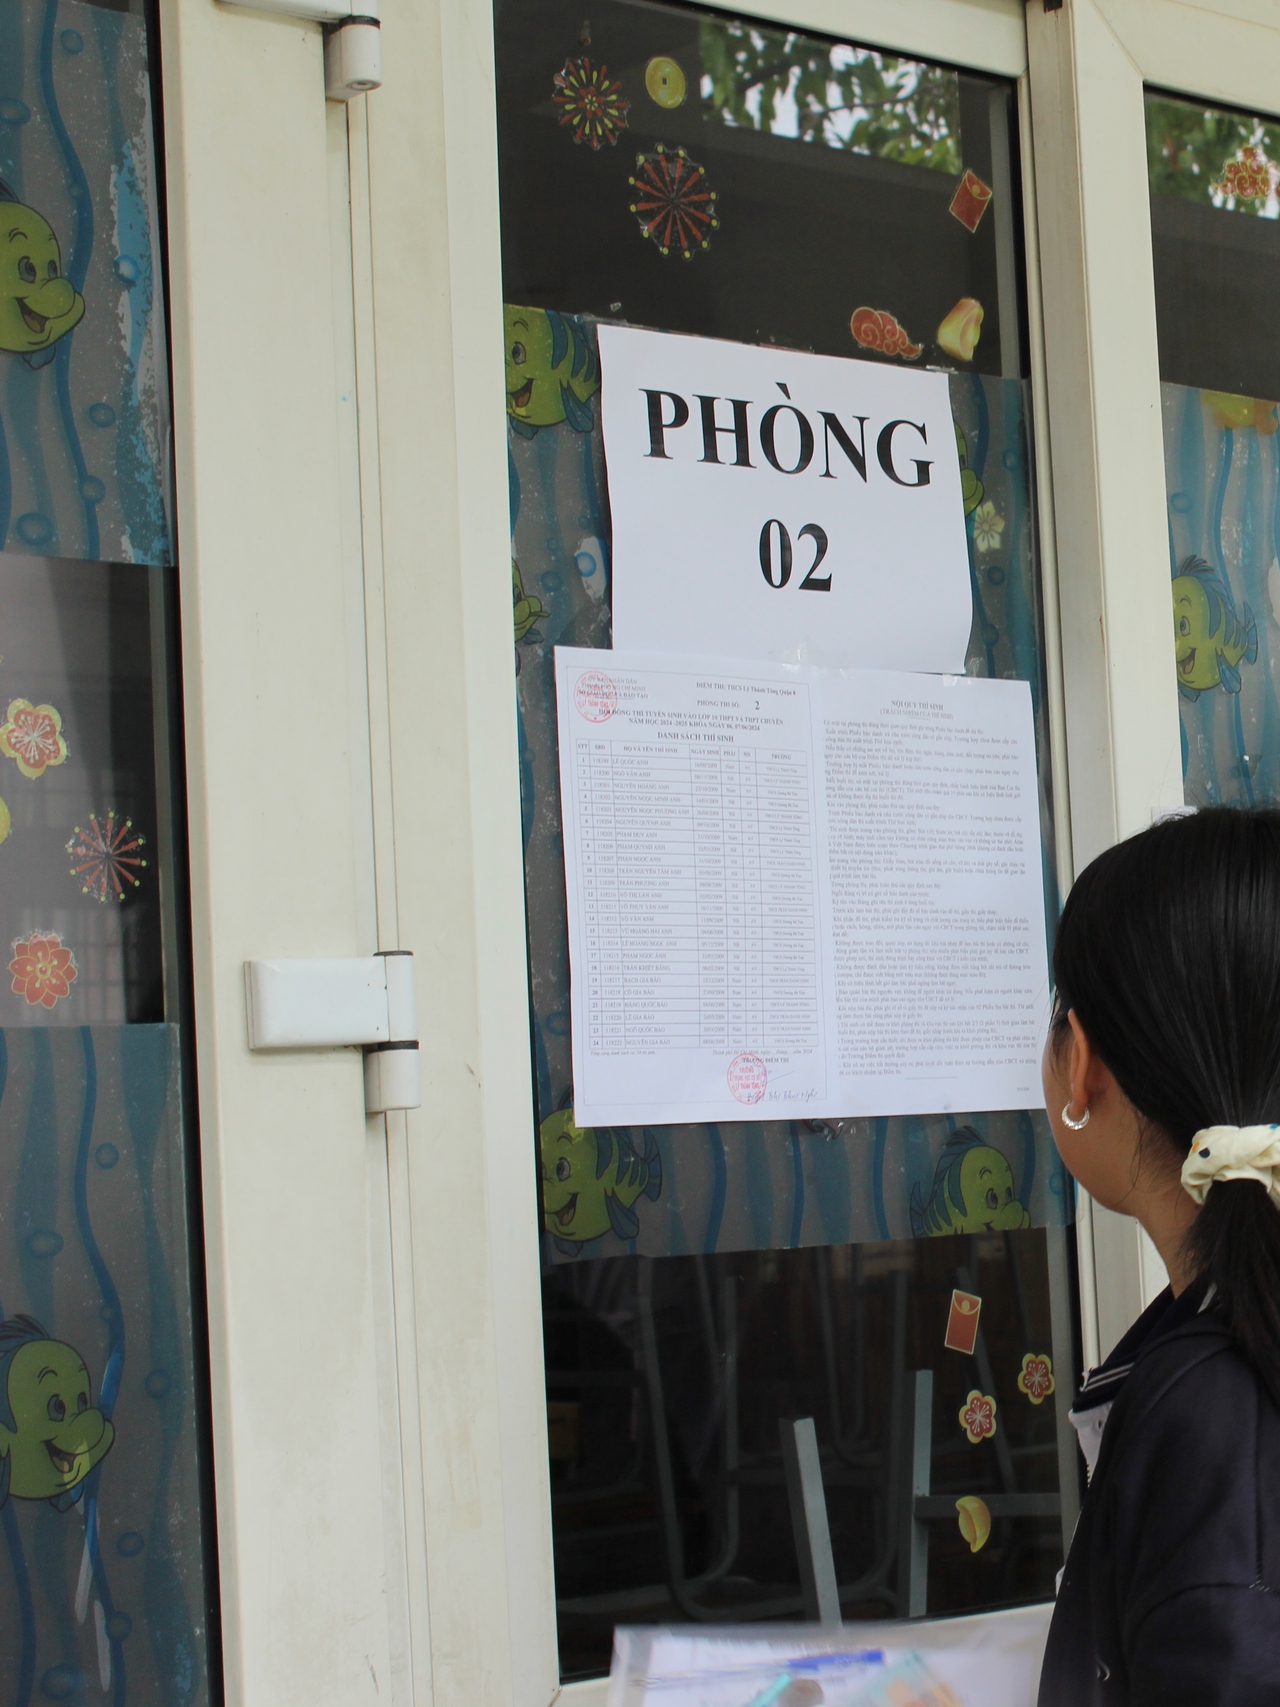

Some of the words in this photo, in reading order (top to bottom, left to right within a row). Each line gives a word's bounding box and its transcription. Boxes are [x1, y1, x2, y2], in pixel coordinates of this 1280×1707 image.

[638, 382, 935, 488] PHÒNG
[759, 518, 833, 592] 02
[755, 700, 760, 710] 2
[658, 731, 679, 739] DANH
[681, 732, 700, 740] SÁCH
